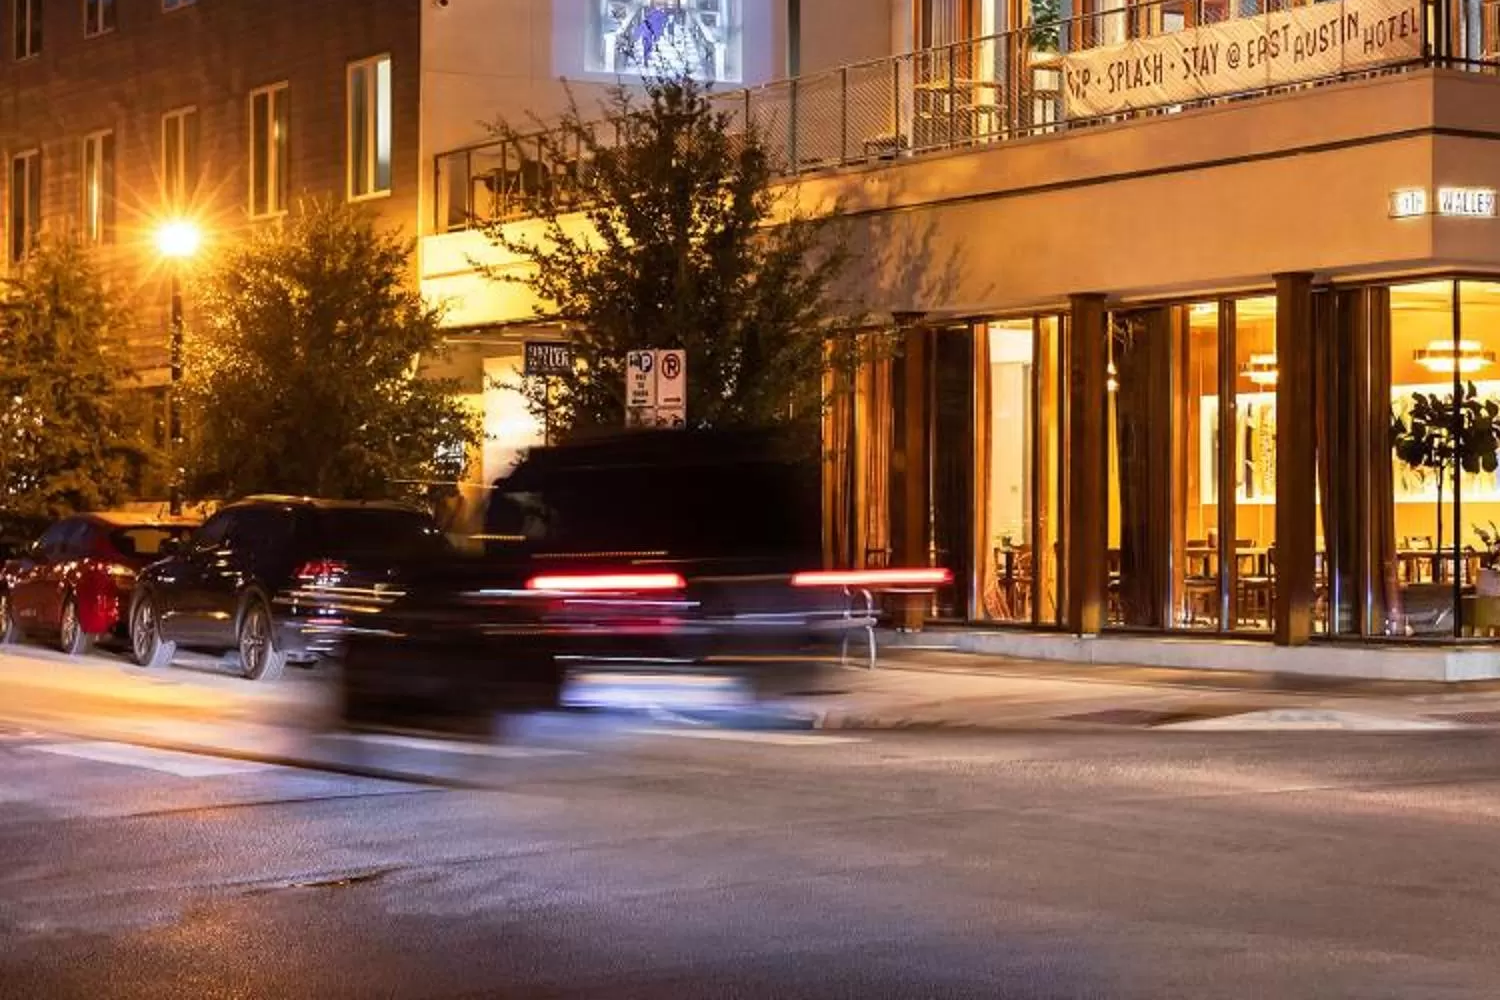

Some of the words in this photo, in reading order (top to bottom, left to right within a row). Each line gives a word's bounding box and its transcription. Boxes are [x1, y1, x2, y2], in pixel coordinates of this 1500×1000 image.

[1108, 52, 1163, 93] SPLASH
[1182, 42, 1219, 79] STAY
[1226, 41, 1241, 69] @
[1247, 23, 1290, 68] EAST
[1294, 11, 1359, 64] AUSTIN
[1363, 7, 1419, 54] HOTEL
